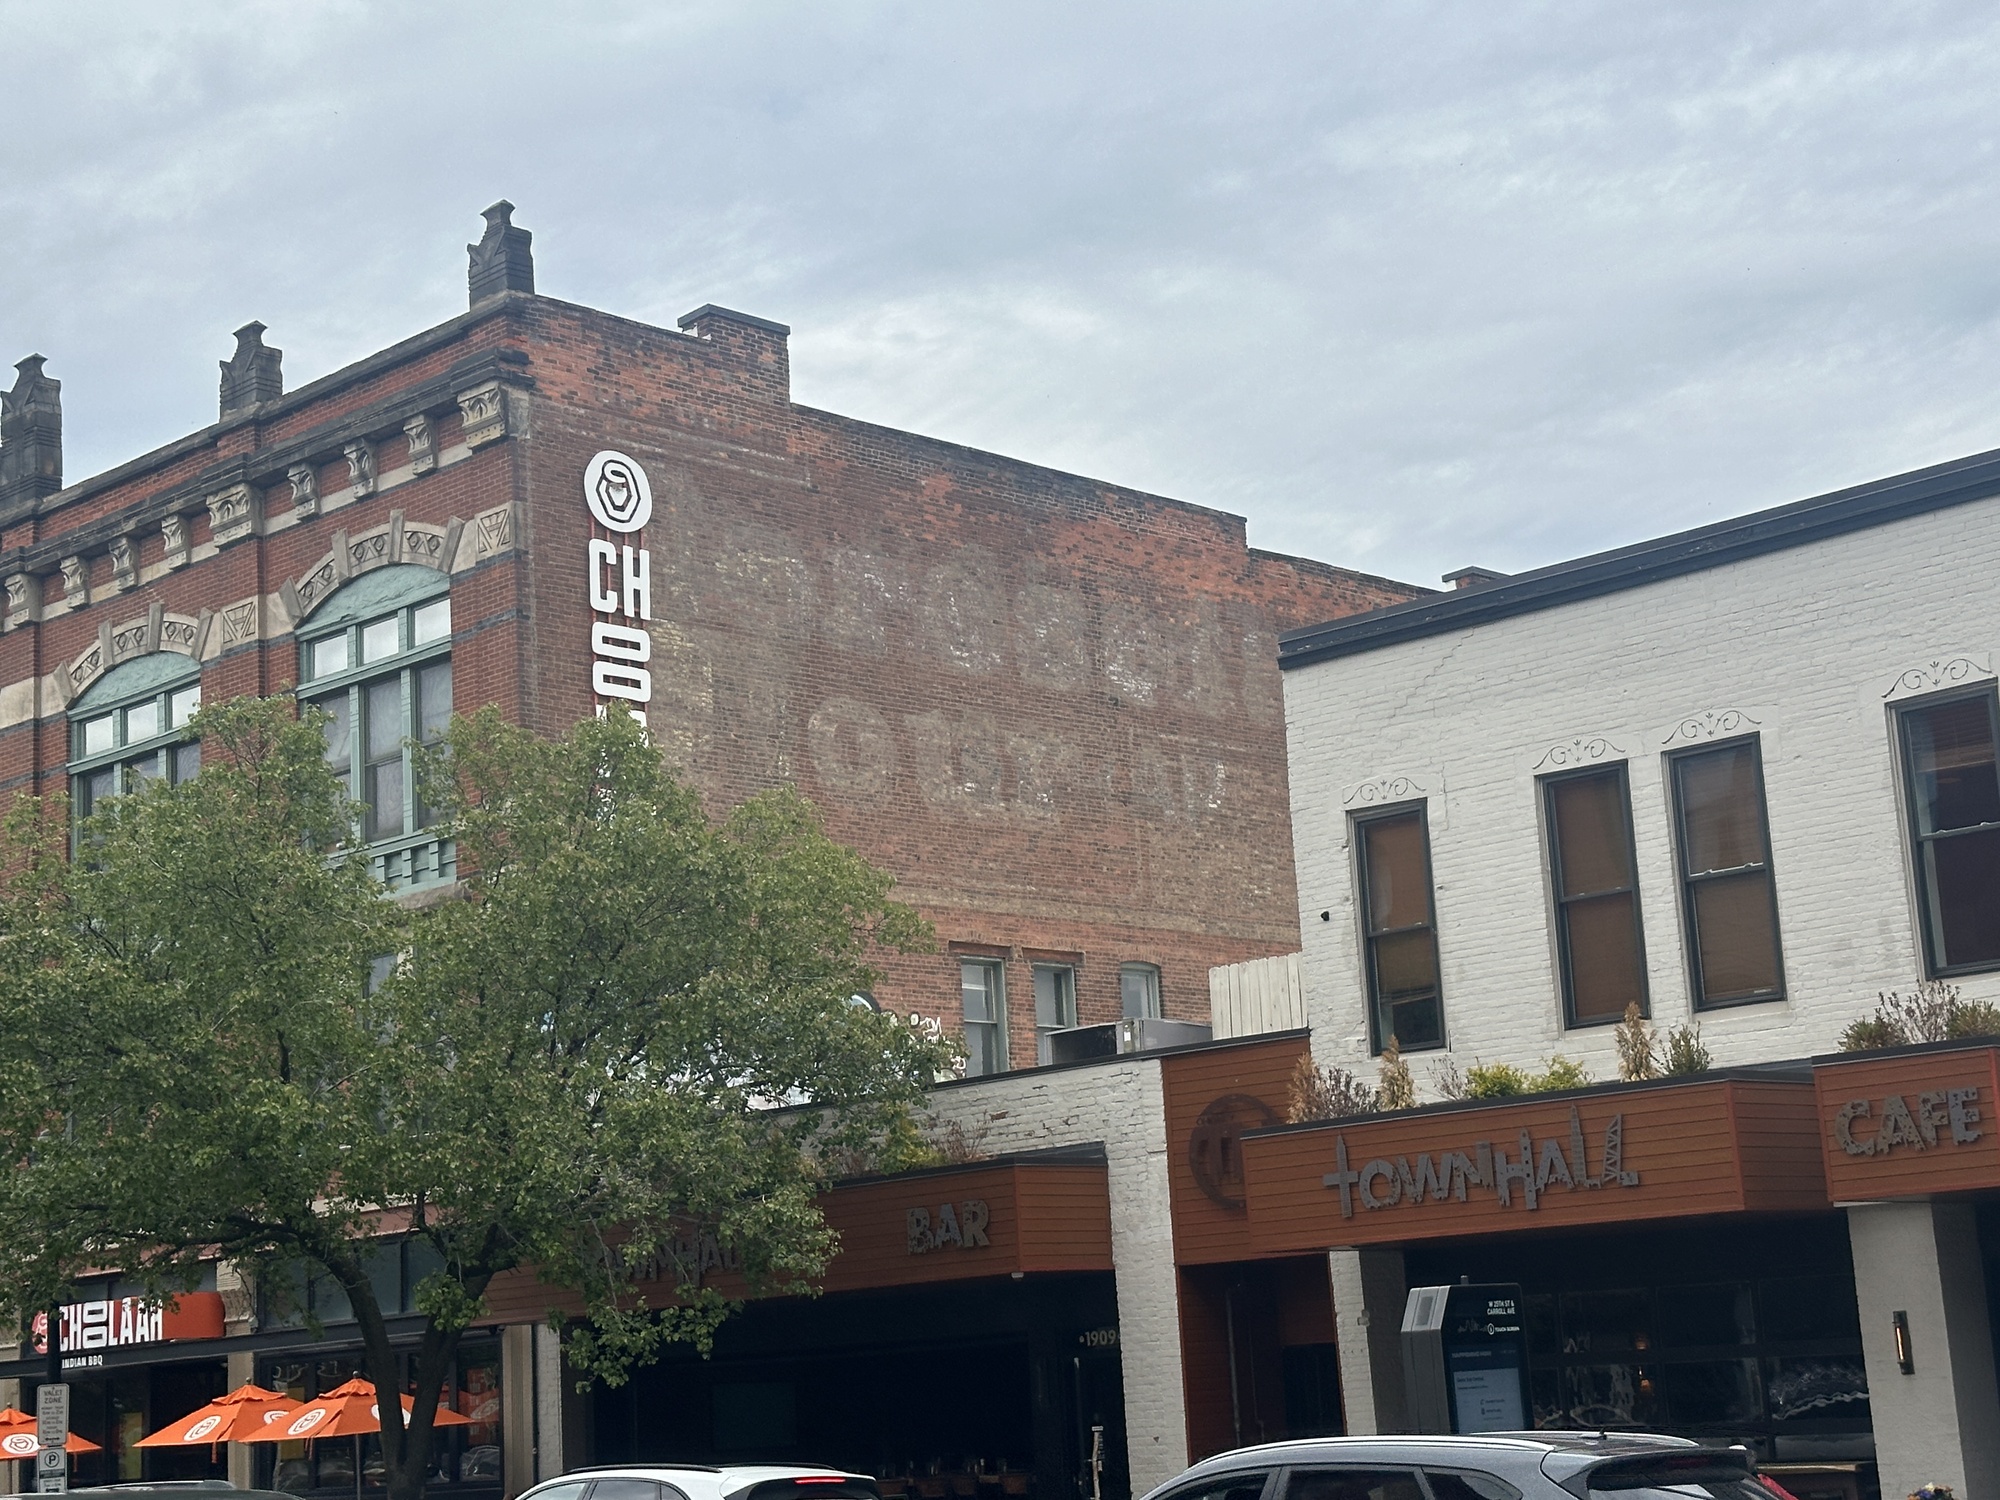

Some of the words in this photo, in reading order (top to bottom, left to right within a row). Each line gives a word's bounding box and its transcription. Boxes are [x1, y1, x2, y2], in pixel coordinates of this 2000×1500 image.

[1834, 1087, 1983, 1157] CAFE
[906, 1199, 991, 1255] BAR
[58, 1296, 163, 1353] CHOOLAAH
[1084, 1329, 1117, 1347] 1909
[61, 1356, 87, 1370] INDIAN
[87, 1354, 104, 1367] BBQ
